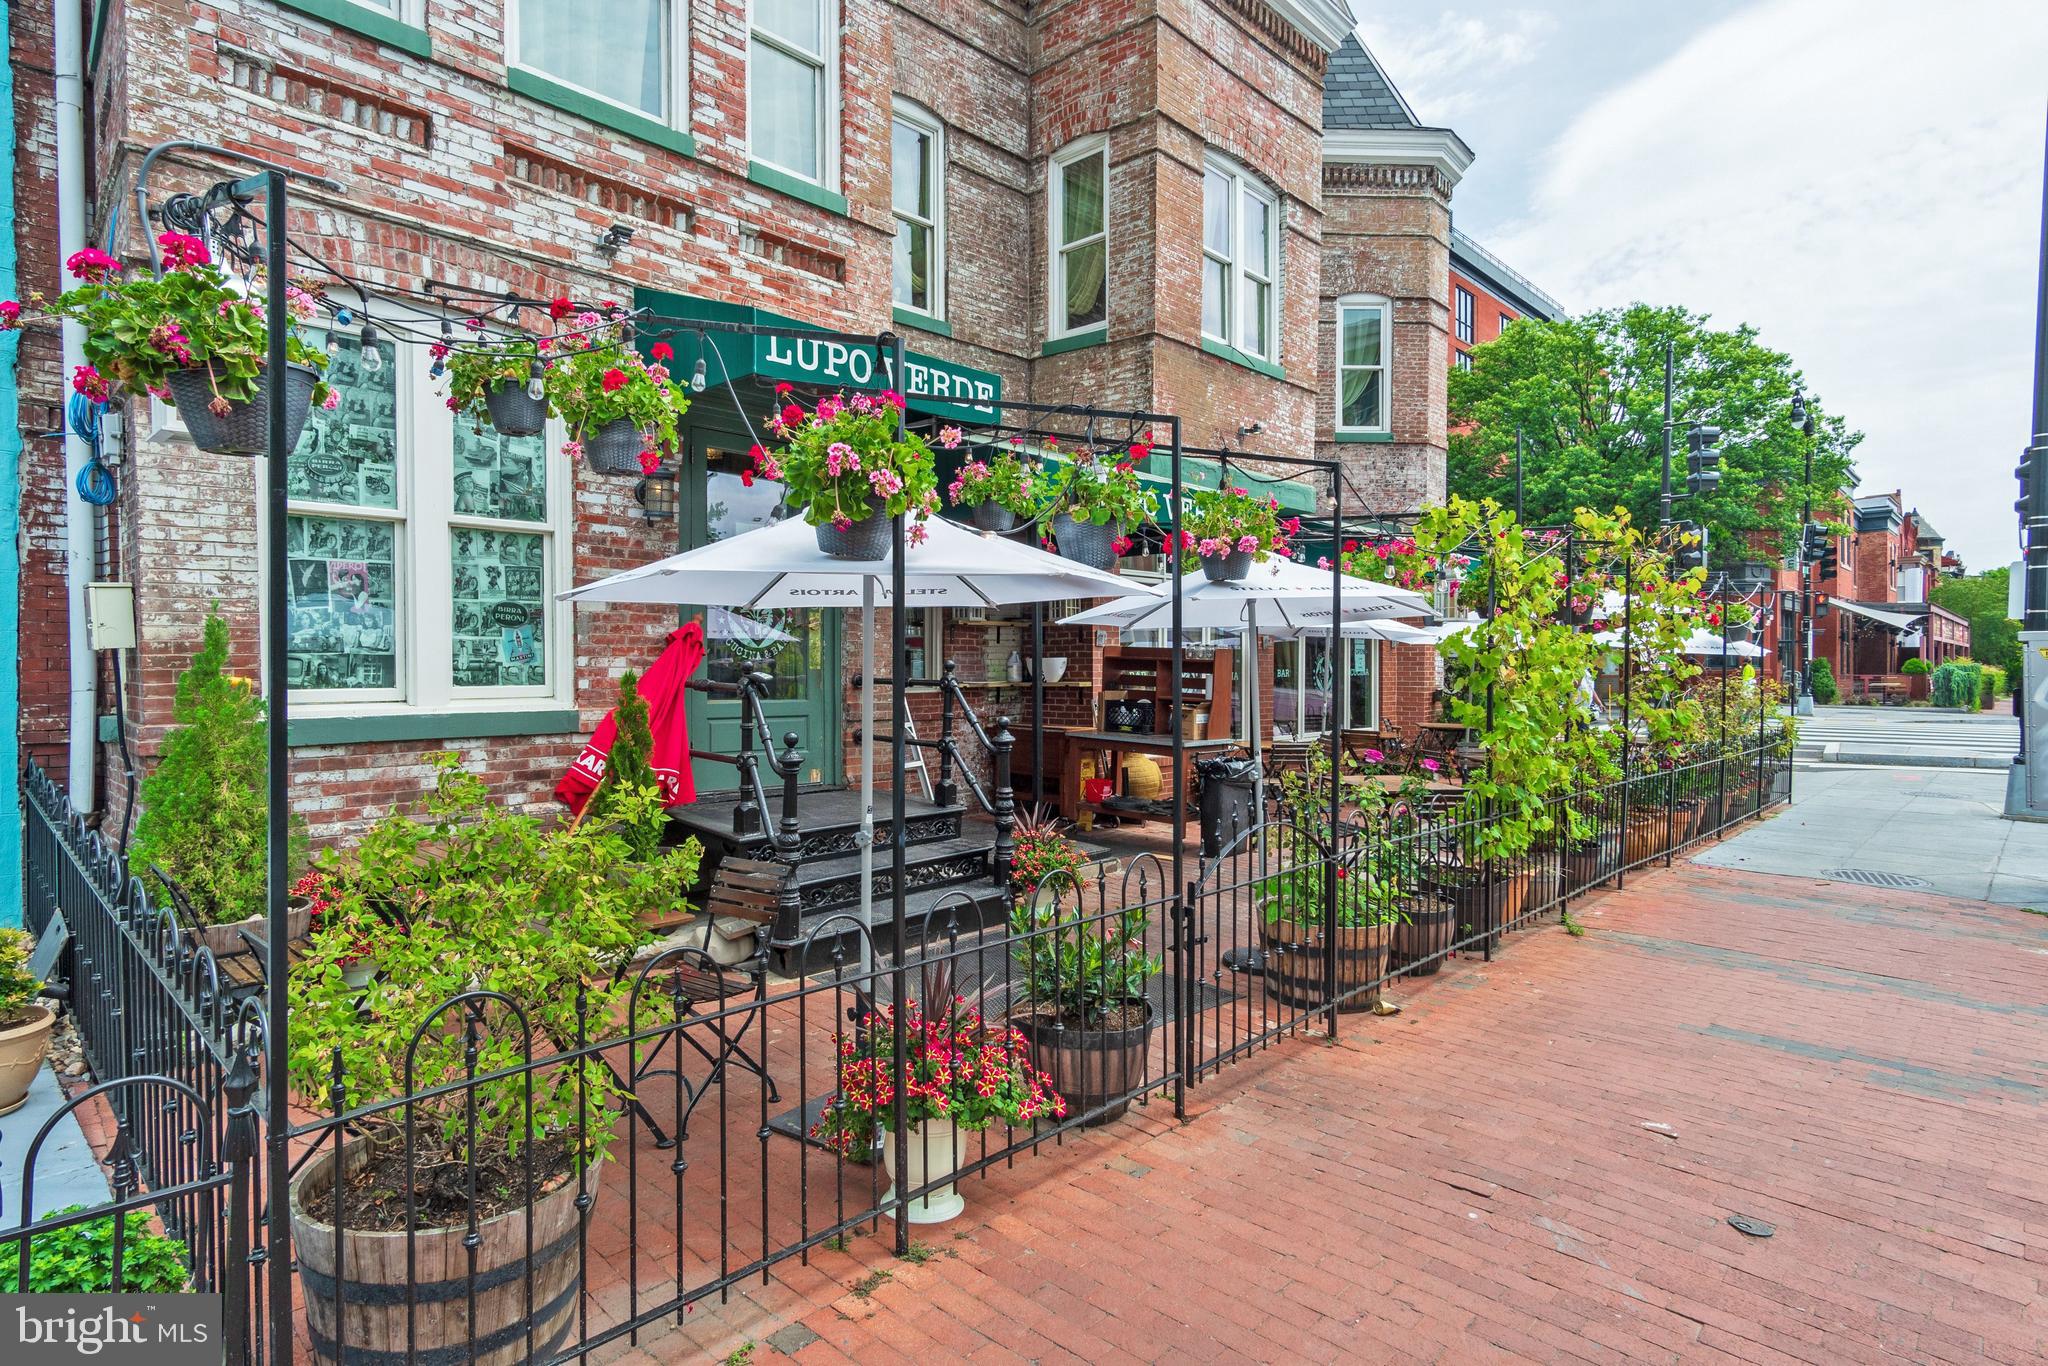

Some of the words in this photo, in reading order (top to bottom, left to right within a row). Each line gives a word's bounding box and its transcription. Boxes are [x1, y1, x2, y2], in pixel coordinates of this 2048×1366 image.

[766, 336, 872, 384] LUPO
[497, 605, 522, 614] BIRRA
[495, 613, 525, 622] PERONI
[726, 638, 762, 660] CUCINA
[511, 653, 535, 661] MARTINI
[1277, 669, 1290, 678] BAR
